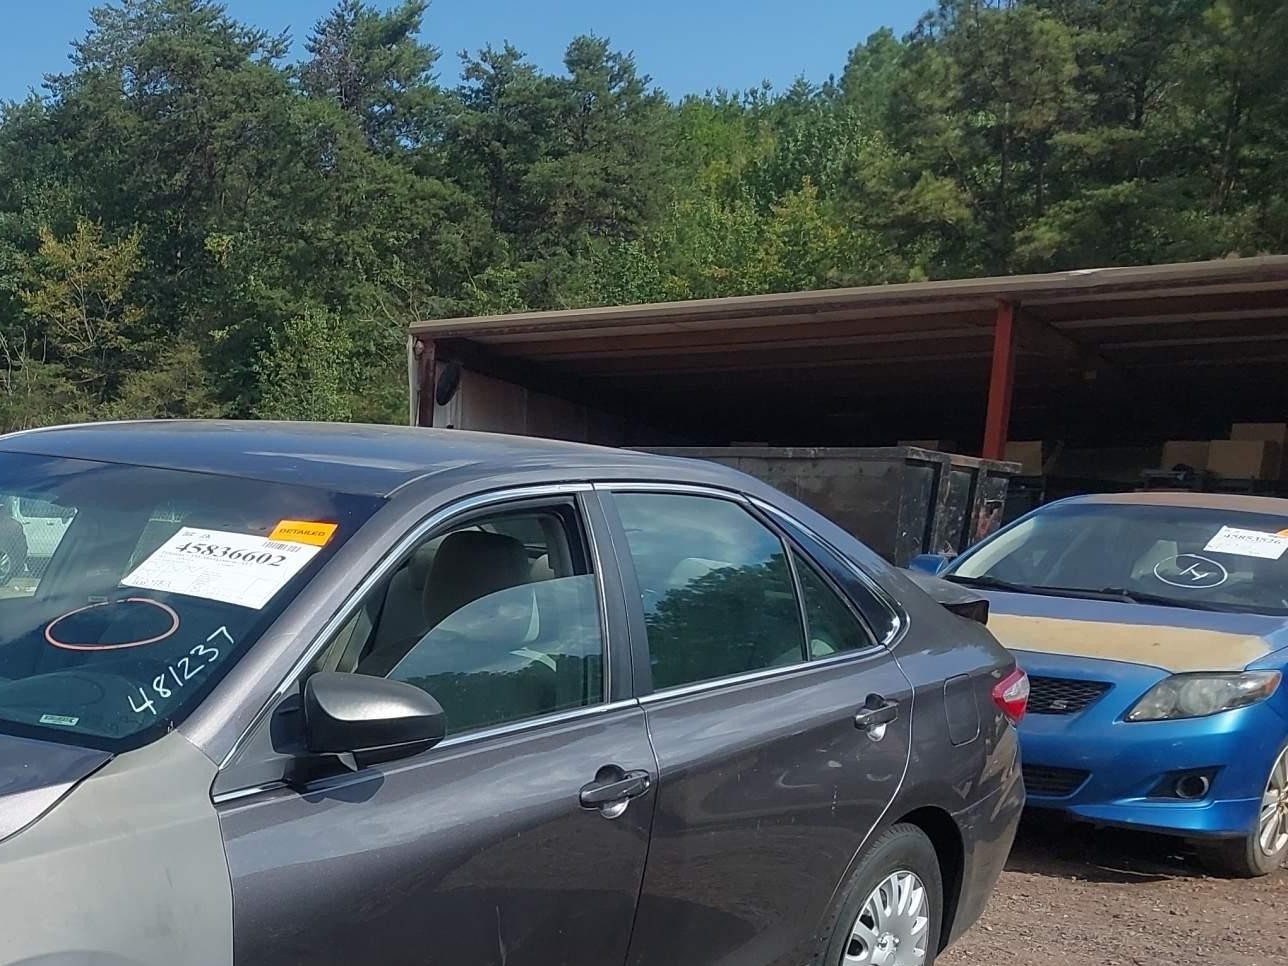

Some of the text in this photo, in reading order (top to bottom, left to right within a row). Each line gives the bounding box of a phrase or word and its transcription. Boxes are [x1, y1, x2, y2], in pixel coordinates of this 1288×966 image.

[279, 528, 326, 537] DETAILED
[176, 541, 287, 567] 45836602
[127, 625, 235, 715] 481237
